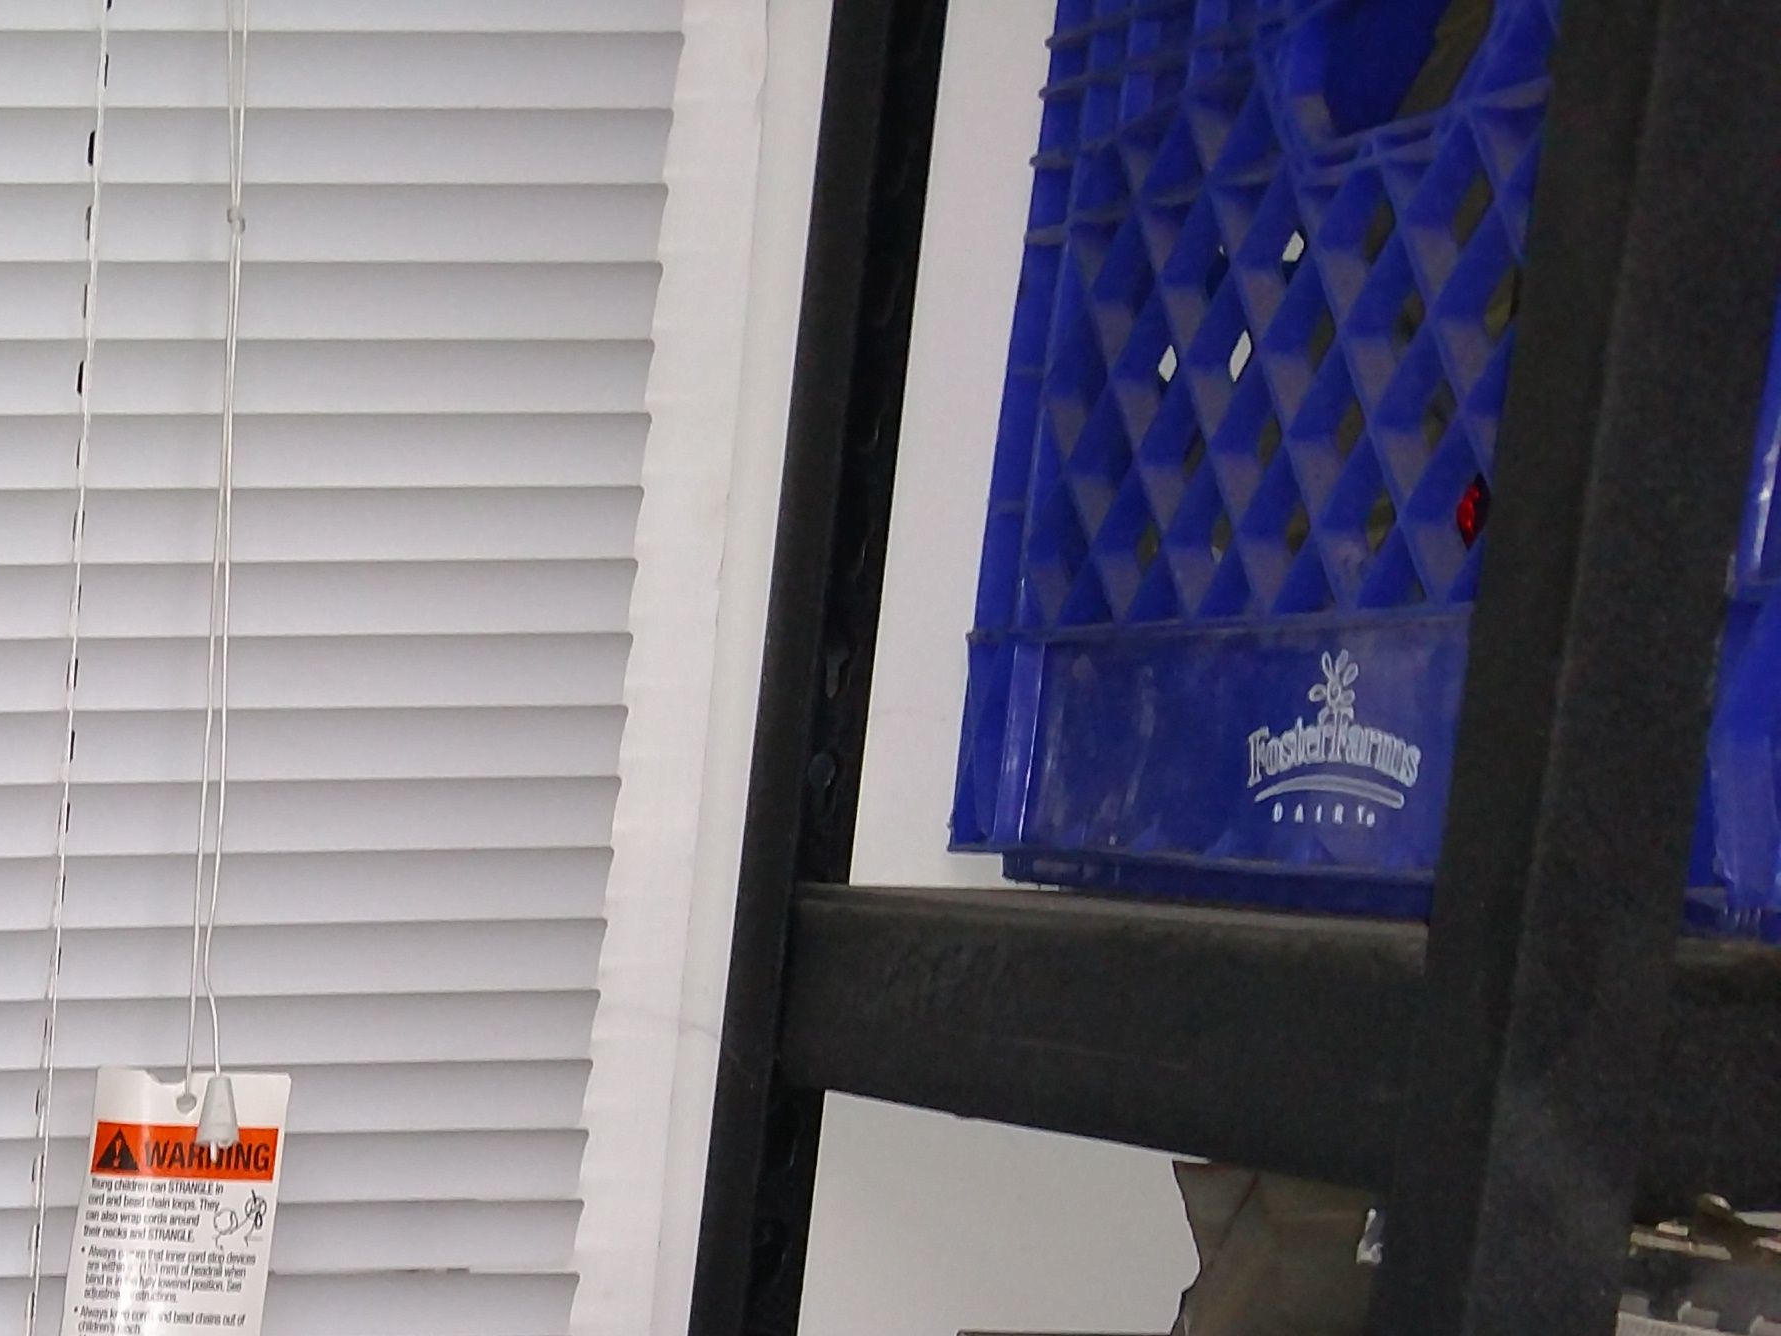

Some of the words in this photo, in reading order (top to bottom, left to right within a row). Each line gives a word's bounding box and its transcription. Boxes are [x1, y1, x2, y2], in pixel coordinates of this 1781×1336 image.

[1272, 802, 1365, 825] DAIRY
[114, 1178, 148, 1191] children
[150, 1182, 166, 1192] can
[168, 1181, 213, 1195] STRANGLE
[199, 1198, 219, 1212] They
[169, 1214, 200, 1227] around
